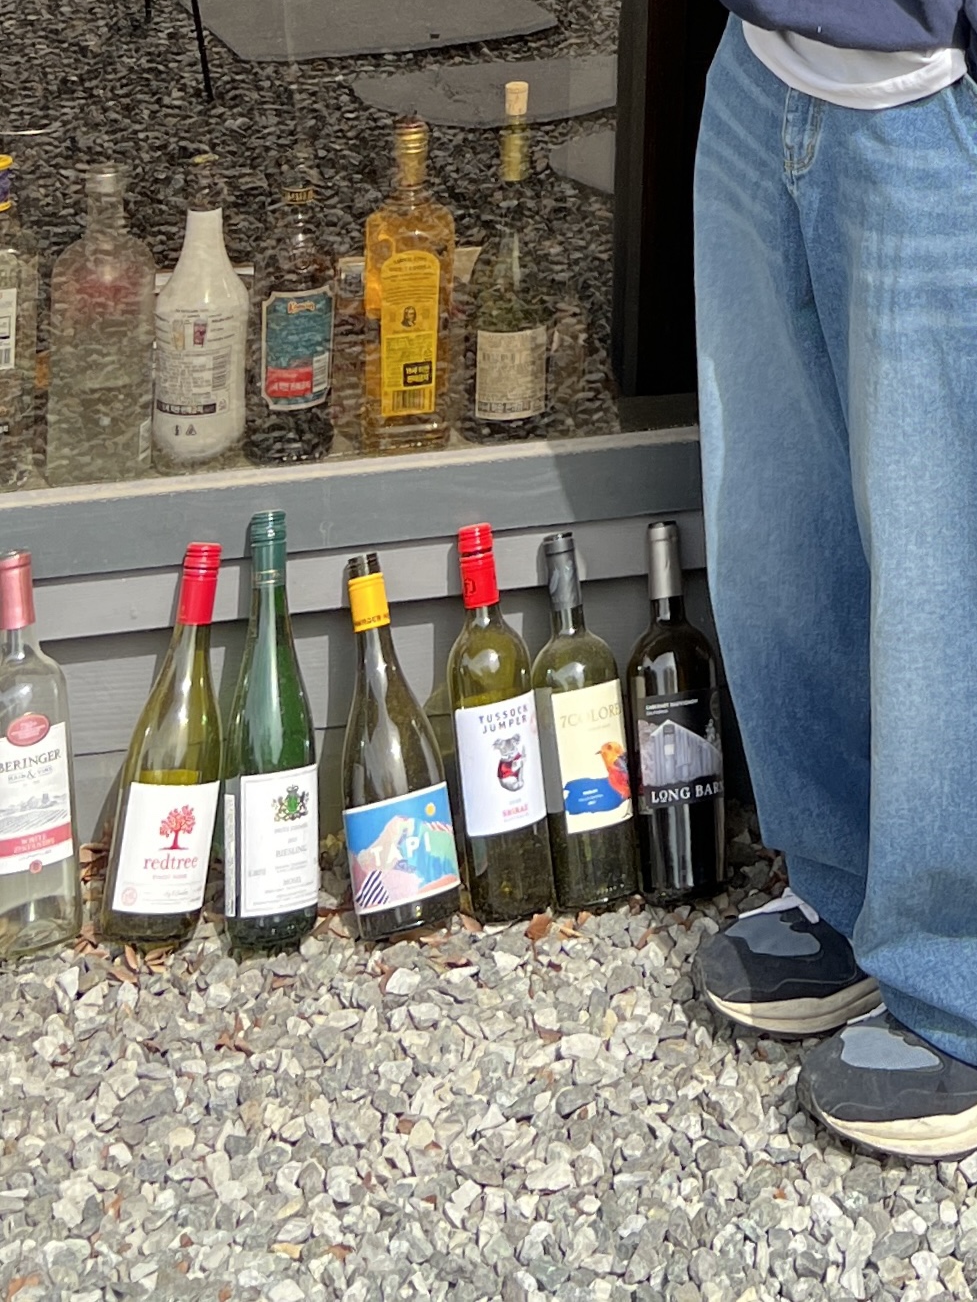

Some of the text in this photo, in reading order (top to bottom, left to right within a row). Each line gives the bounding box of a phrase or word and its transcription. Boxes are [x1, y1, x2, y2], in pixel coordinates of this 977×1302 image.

[478, 704, 528, 725] TUSSOCK
[482, 715, 527, 735] JUMPER
[0, 748, 62, 774] BERINGER
[651, 786, 691, 804] LONG
[143, 852, 199, 870] redtree
